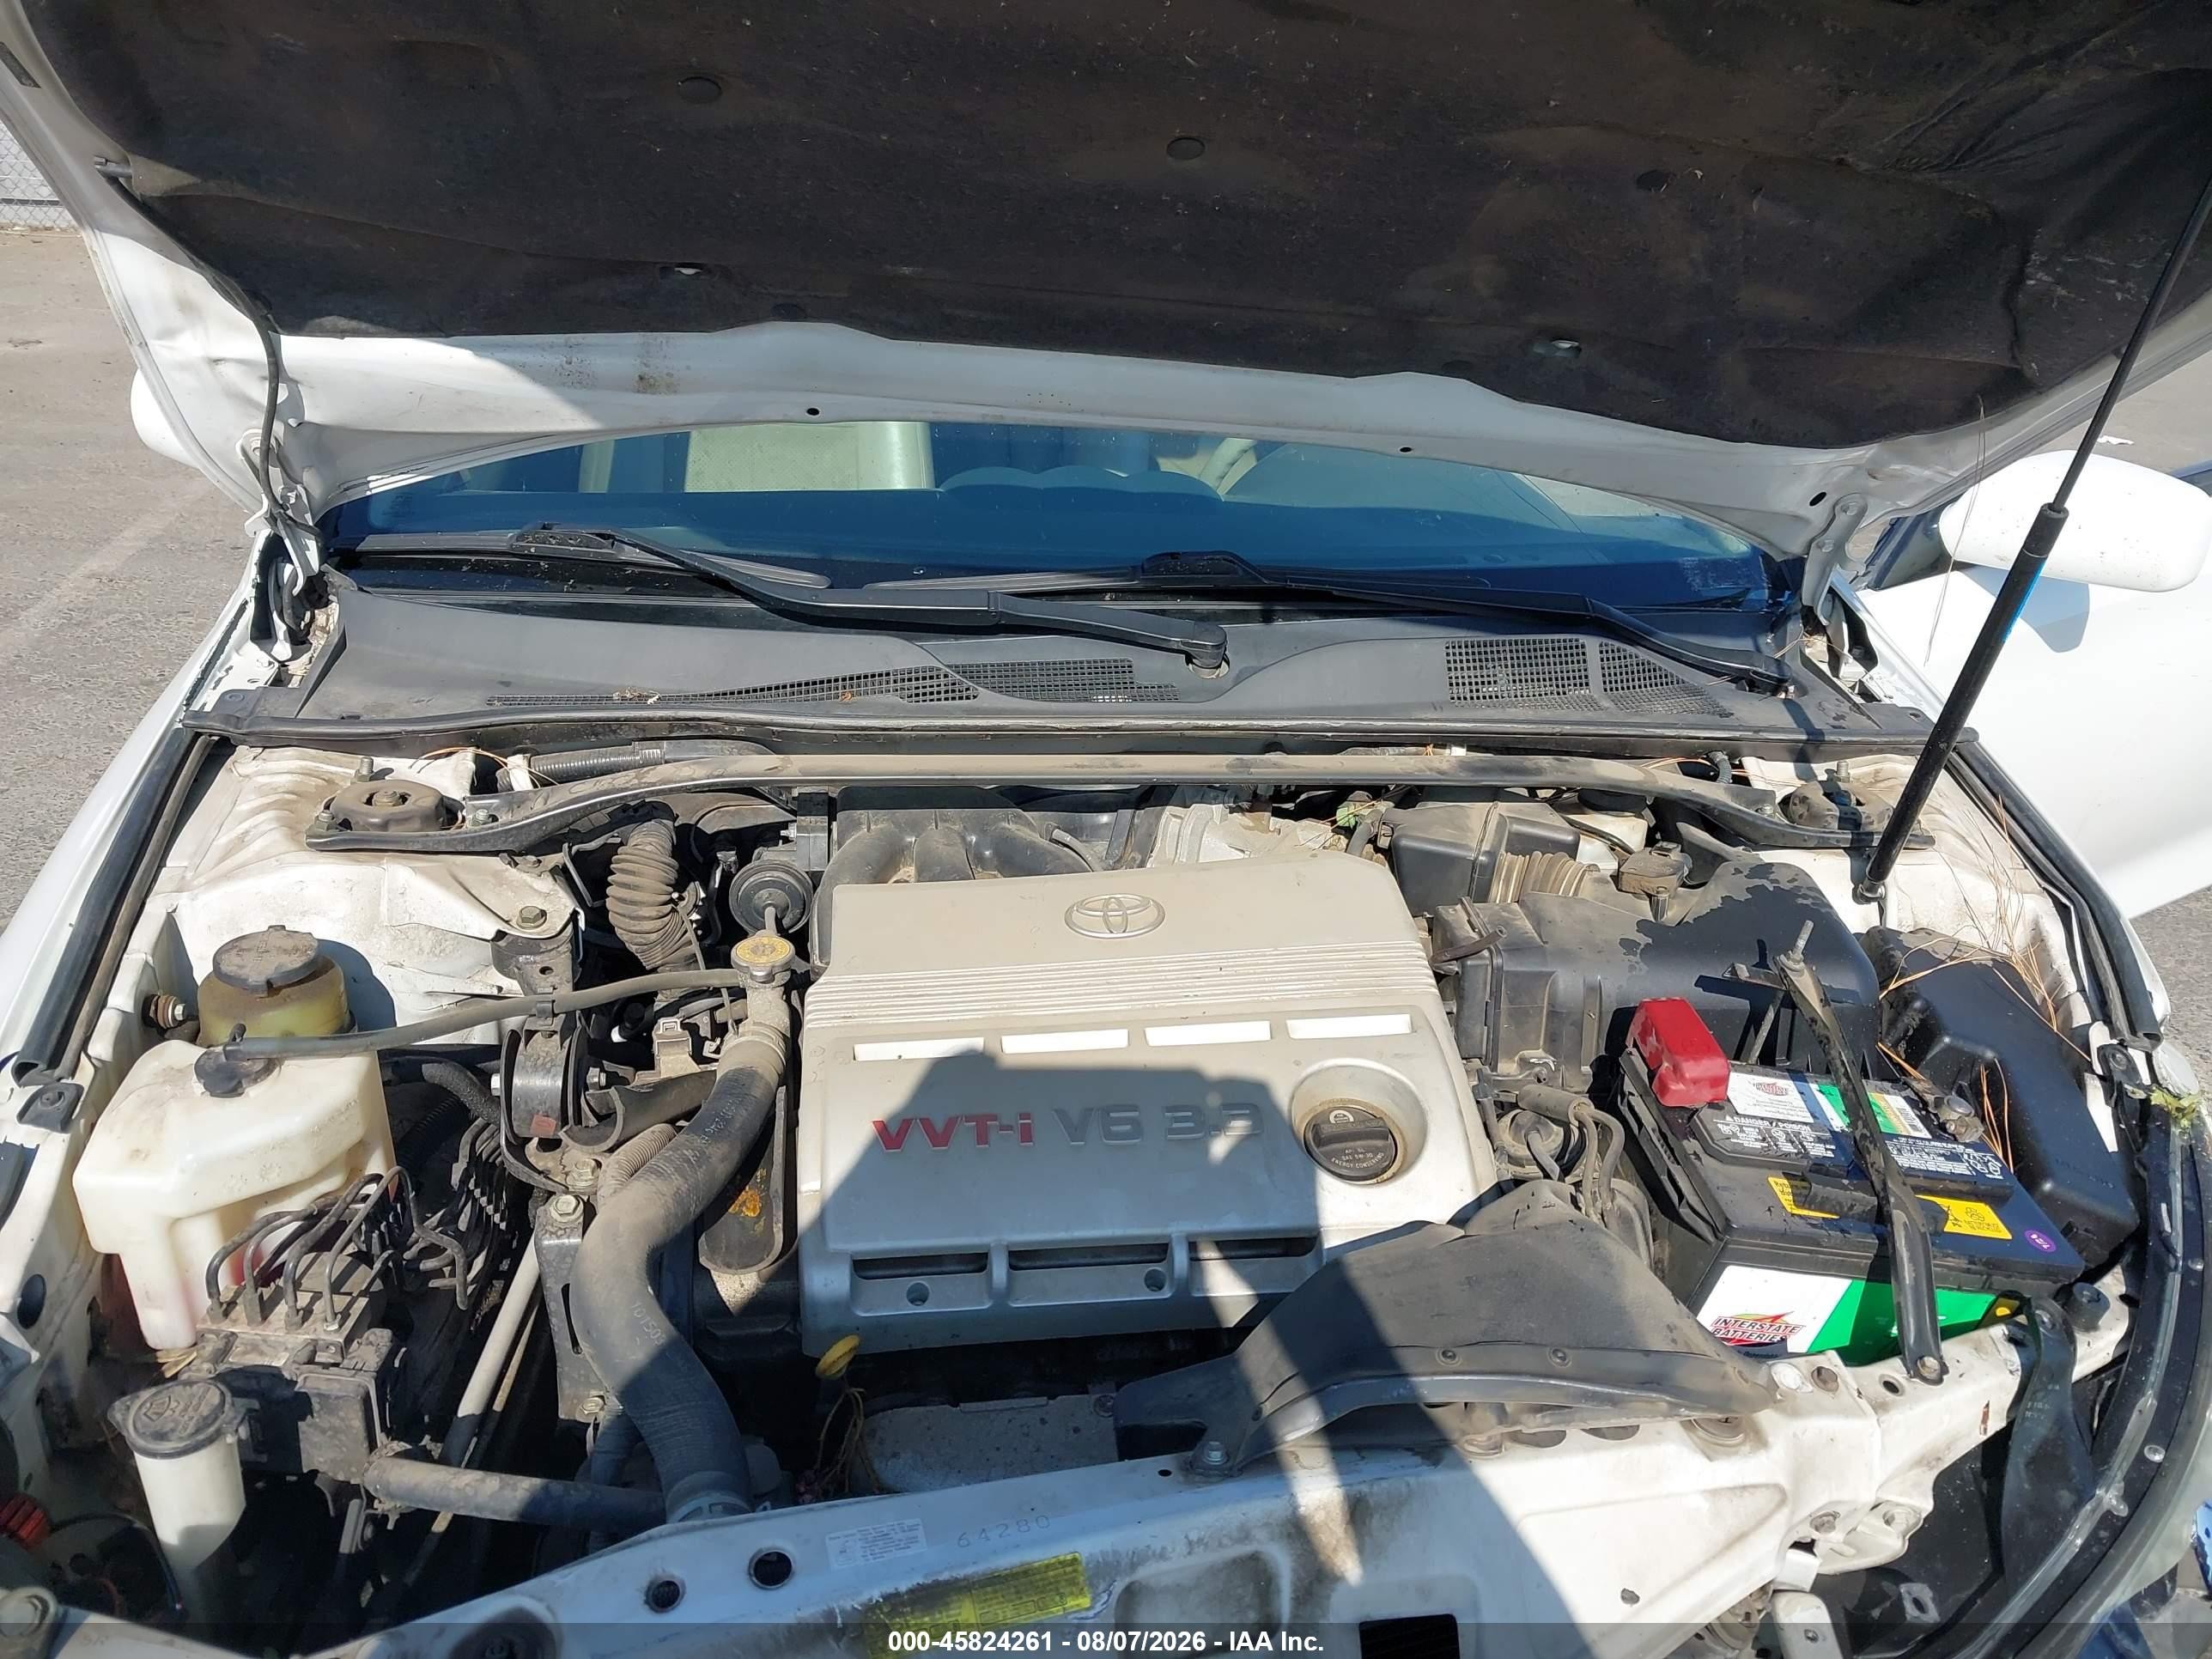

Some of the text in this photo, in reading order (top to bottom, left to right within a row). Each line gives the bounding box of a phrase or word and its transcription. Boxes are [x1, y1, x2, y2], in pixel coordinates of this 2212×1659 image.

[872, 1102, 1265, 1152] VVT-i V6 3.3
[1733, 1115, 1771, 1127] DANGER
[1778, 1121, 1812, 1133] POISON
[1331, 1157, 1353, 1169] ENERGY
[1714, 1317, 1801, 1334] INTERSTATE
[1712, 1328, 1788, 1343] BATTERIES
[957, 1515, 1051, 1548] 64280
